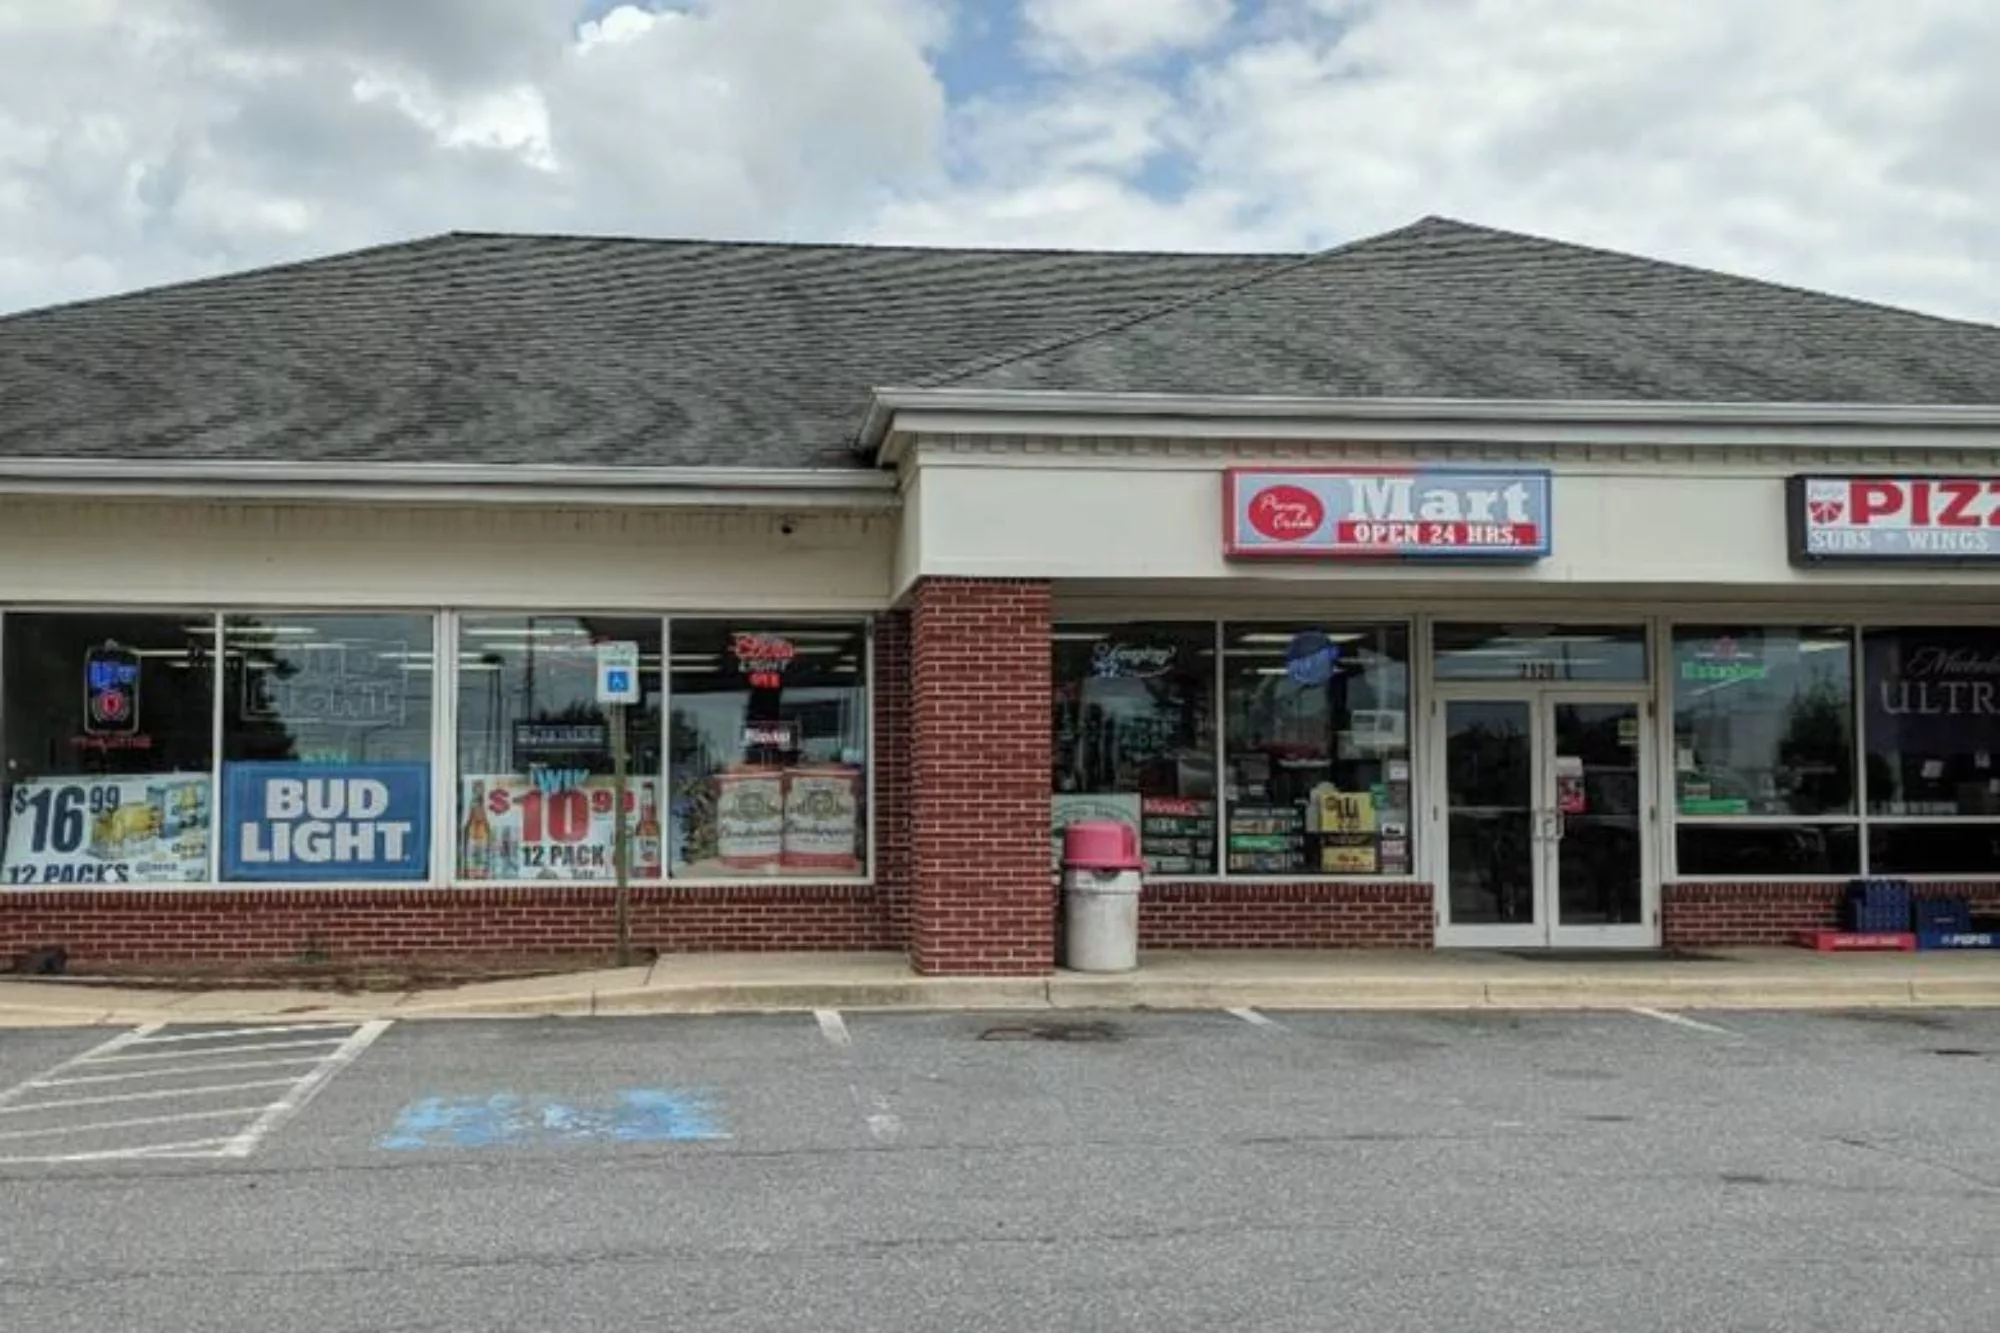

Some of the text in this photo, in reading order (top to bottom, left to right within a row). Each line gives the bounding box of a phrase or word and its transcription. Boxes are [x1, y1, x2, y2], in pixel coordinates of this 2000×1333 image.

[1348, 477, 1530, 522] Mart
[1354, 523, 1419, 545] OPEN
[1430, 523, 1455, 545] 24
[1811, 530, 1990, 551] SUBS WINGS
[1881, 680, 2000, 715] ULTR
[266, 778, 388, 819] BUD
[241, 822, 411, 863] LIGHT
[523, 845, 604, 867] 12 PACK
[8, 865, 37, 884] 12
